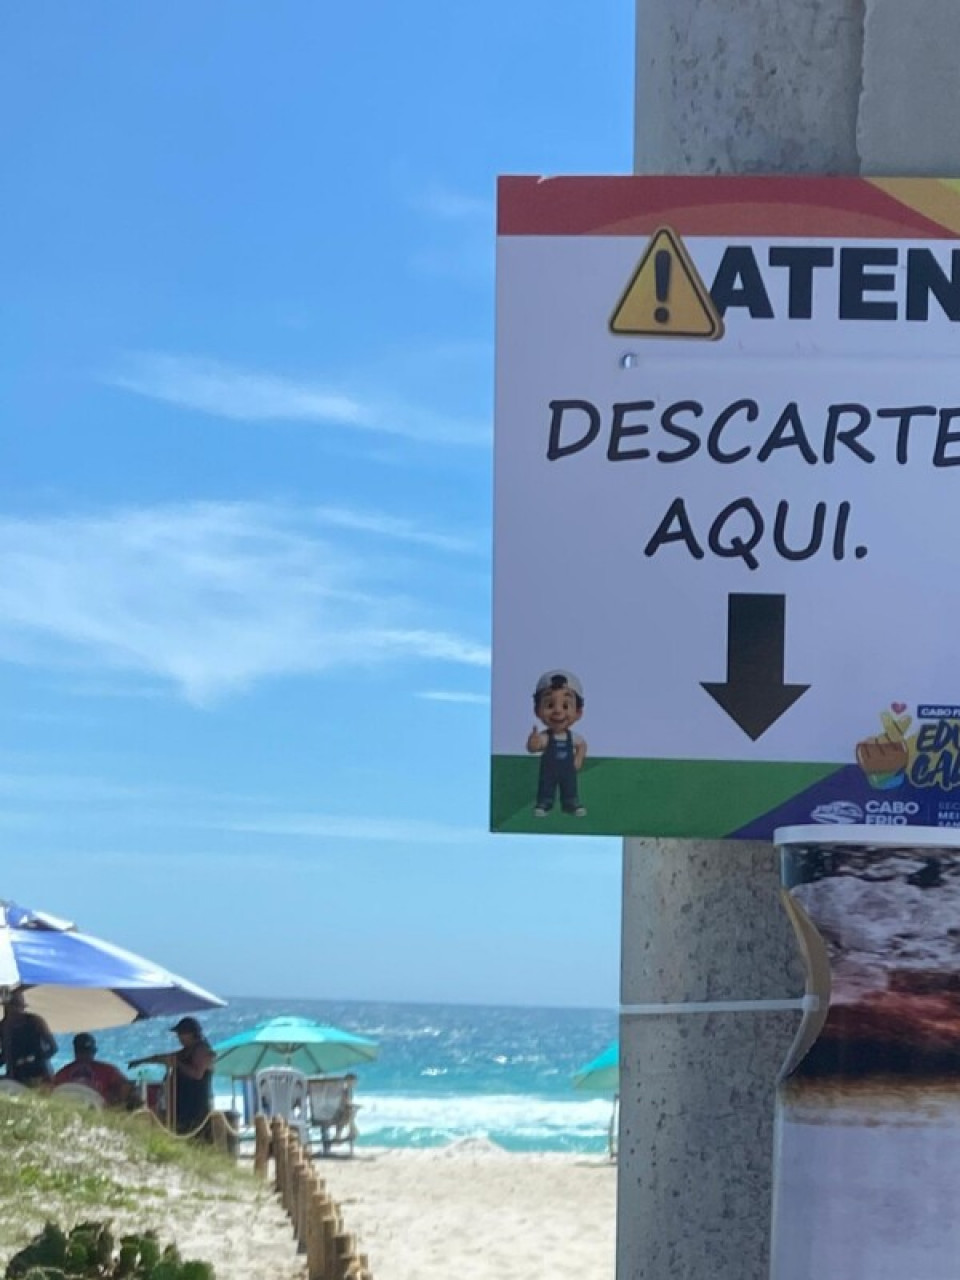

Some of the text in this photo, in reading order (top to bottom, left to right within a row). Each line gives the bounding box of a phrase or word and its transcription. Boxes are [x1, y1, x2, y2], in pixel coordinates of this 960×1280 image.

[644, 497, 868, 571] AQUI.
[920, 707, 950, 717] CABO
[865, 801, 919, 814] CABO
[866, 815, 907, 825] FRIO
